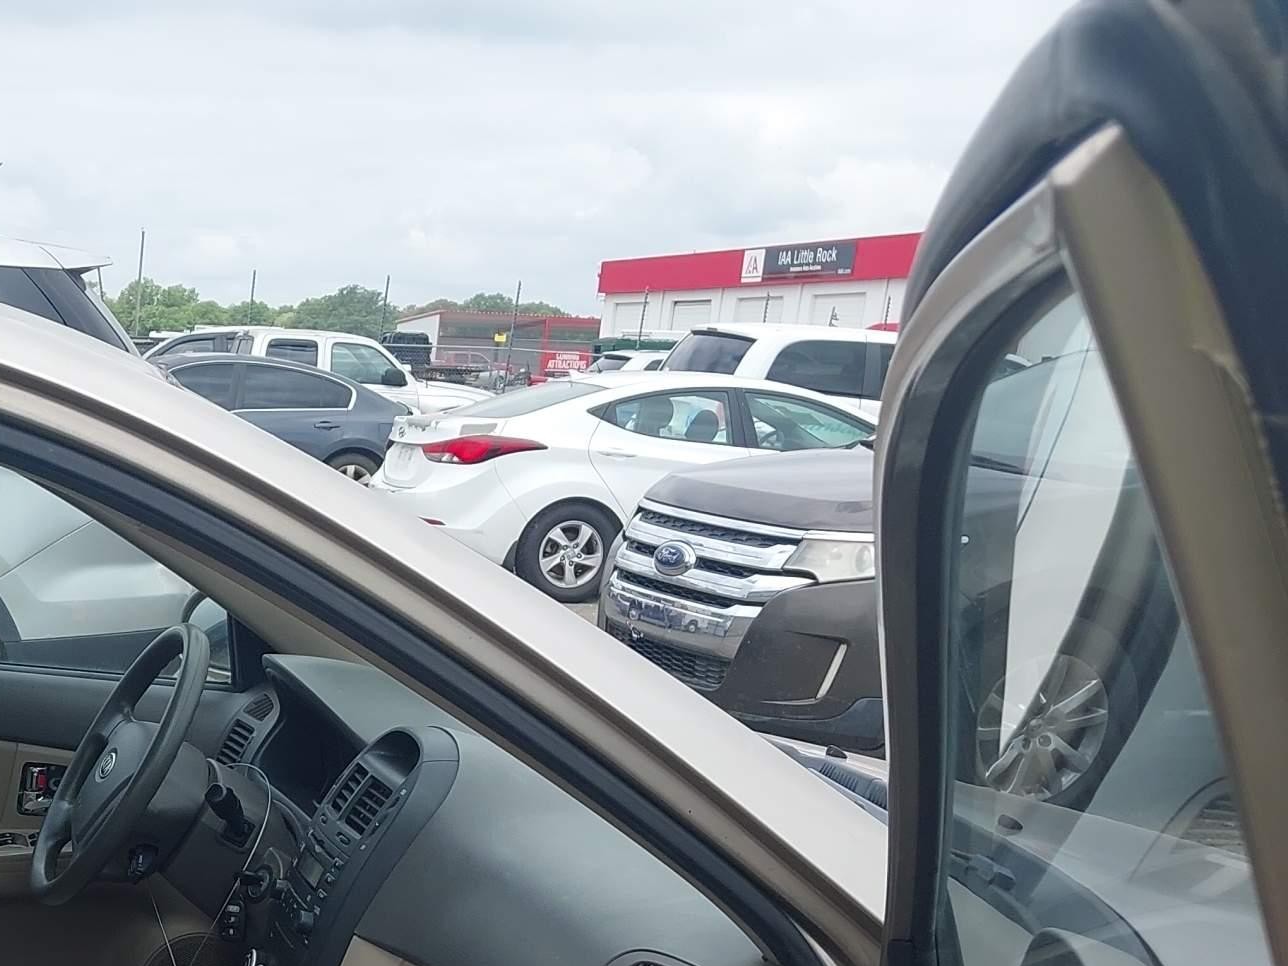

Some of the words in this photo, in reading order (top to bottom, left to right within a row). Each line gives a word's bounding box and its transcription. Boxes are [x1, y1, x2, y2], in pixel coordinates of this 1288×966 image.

[777, 250, 792, 265] IAA
[793, 248, 814, 264] Little
[816, 246, 838, 263] Rock
